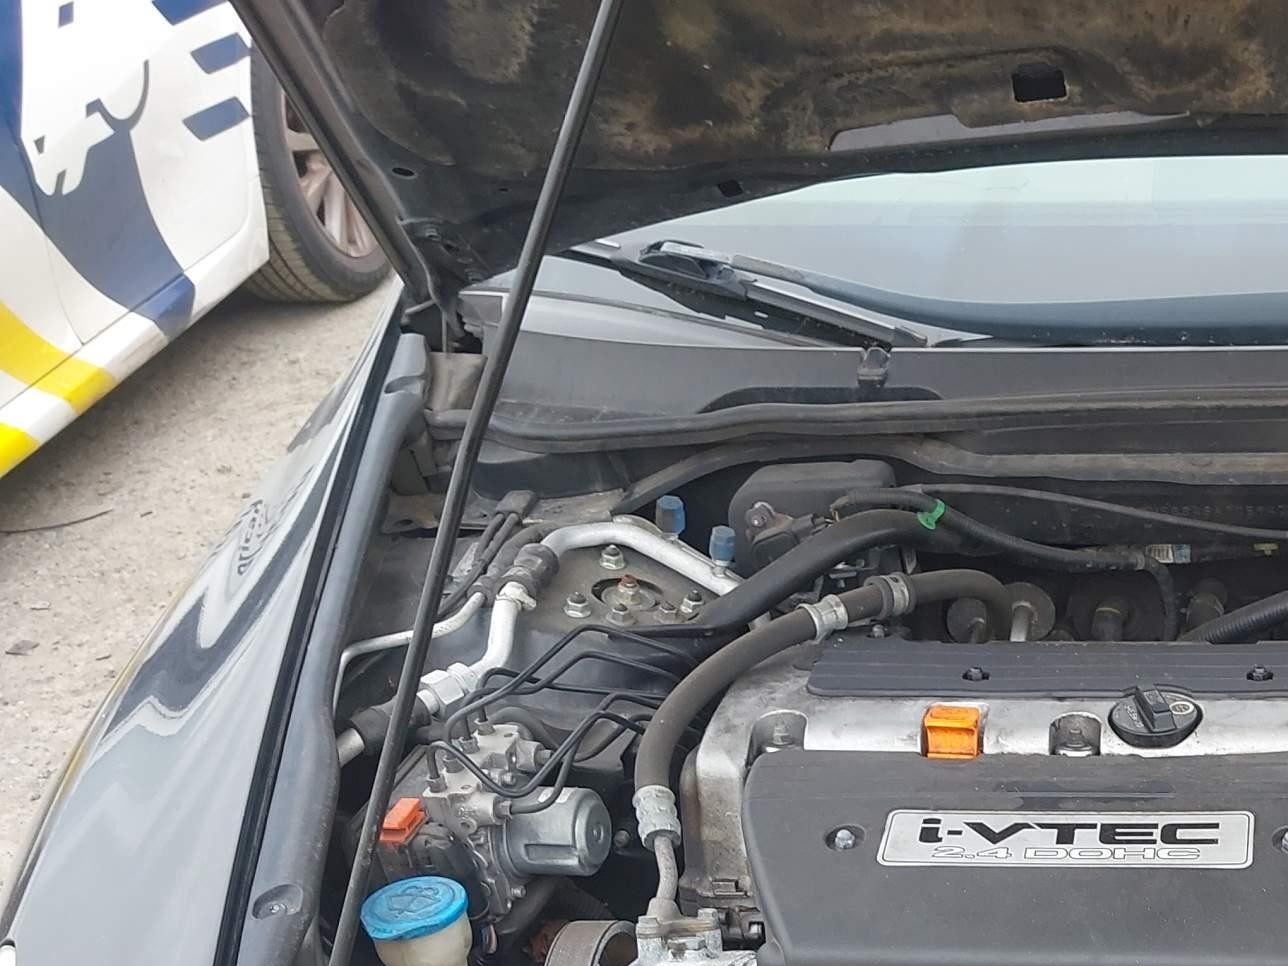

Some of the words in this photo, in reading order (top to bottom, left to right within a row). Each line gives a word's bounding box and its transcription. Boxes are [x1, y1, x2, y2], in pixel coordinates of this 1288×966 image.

[918, 817, 1220, 845] i-VTEC
[931, 846, 1013, 860] 2.4
[1024, 847, 1201, 860] DOHC
